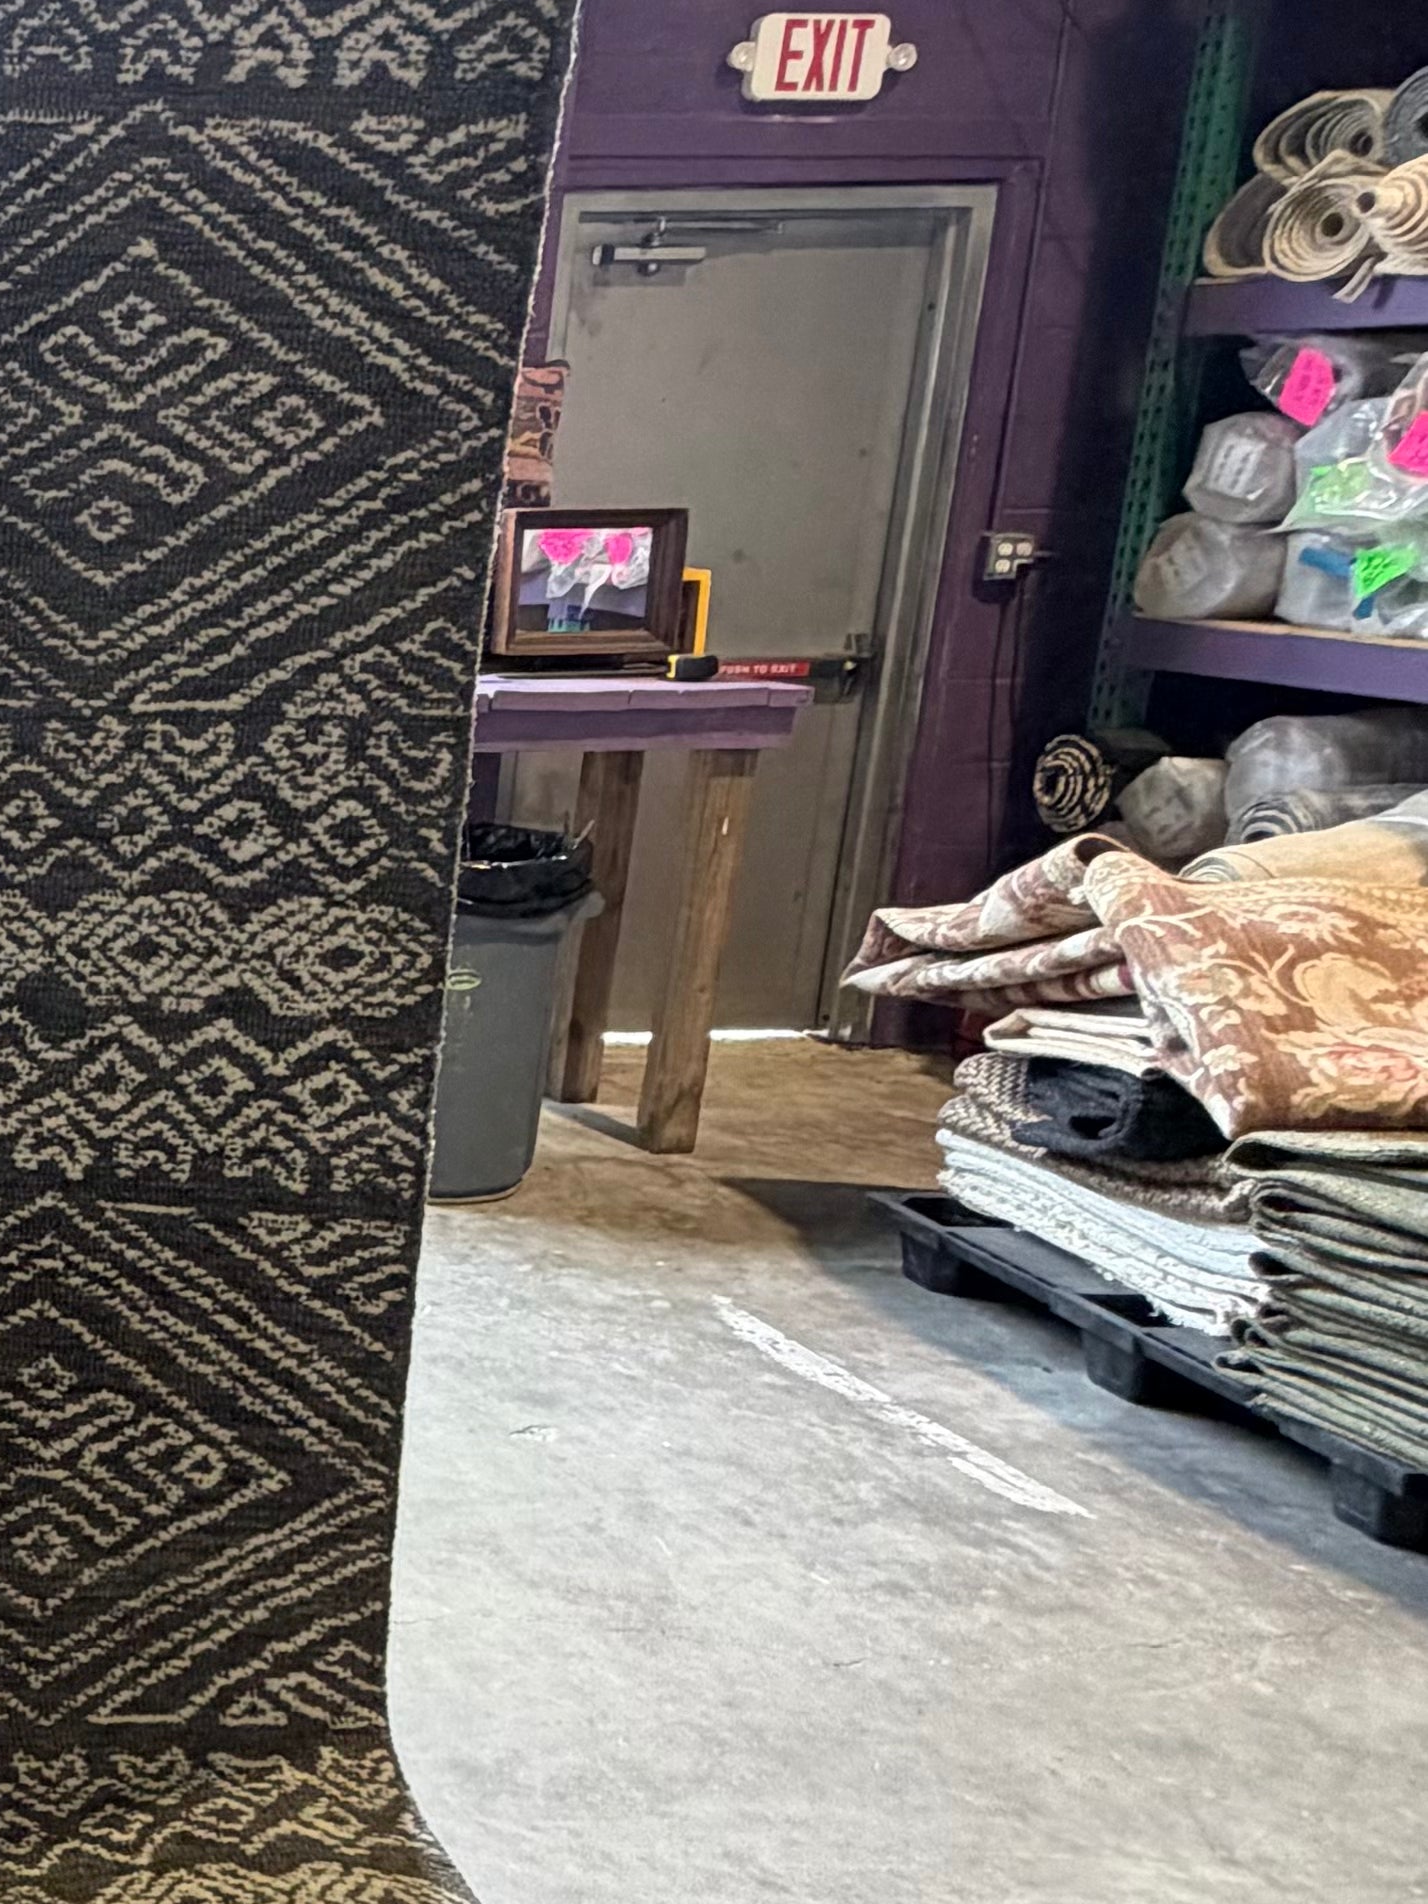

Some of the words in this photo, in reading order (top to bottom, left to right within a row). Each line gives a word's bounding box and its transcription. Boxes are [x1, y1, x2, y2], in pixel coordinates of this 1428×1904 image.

[775, 19, 876, 92] EXIT
[719, 664, 750, 674] PUSH
[753, 664, 768, 674] TO
[771, 663, 796, 673] EXIT
